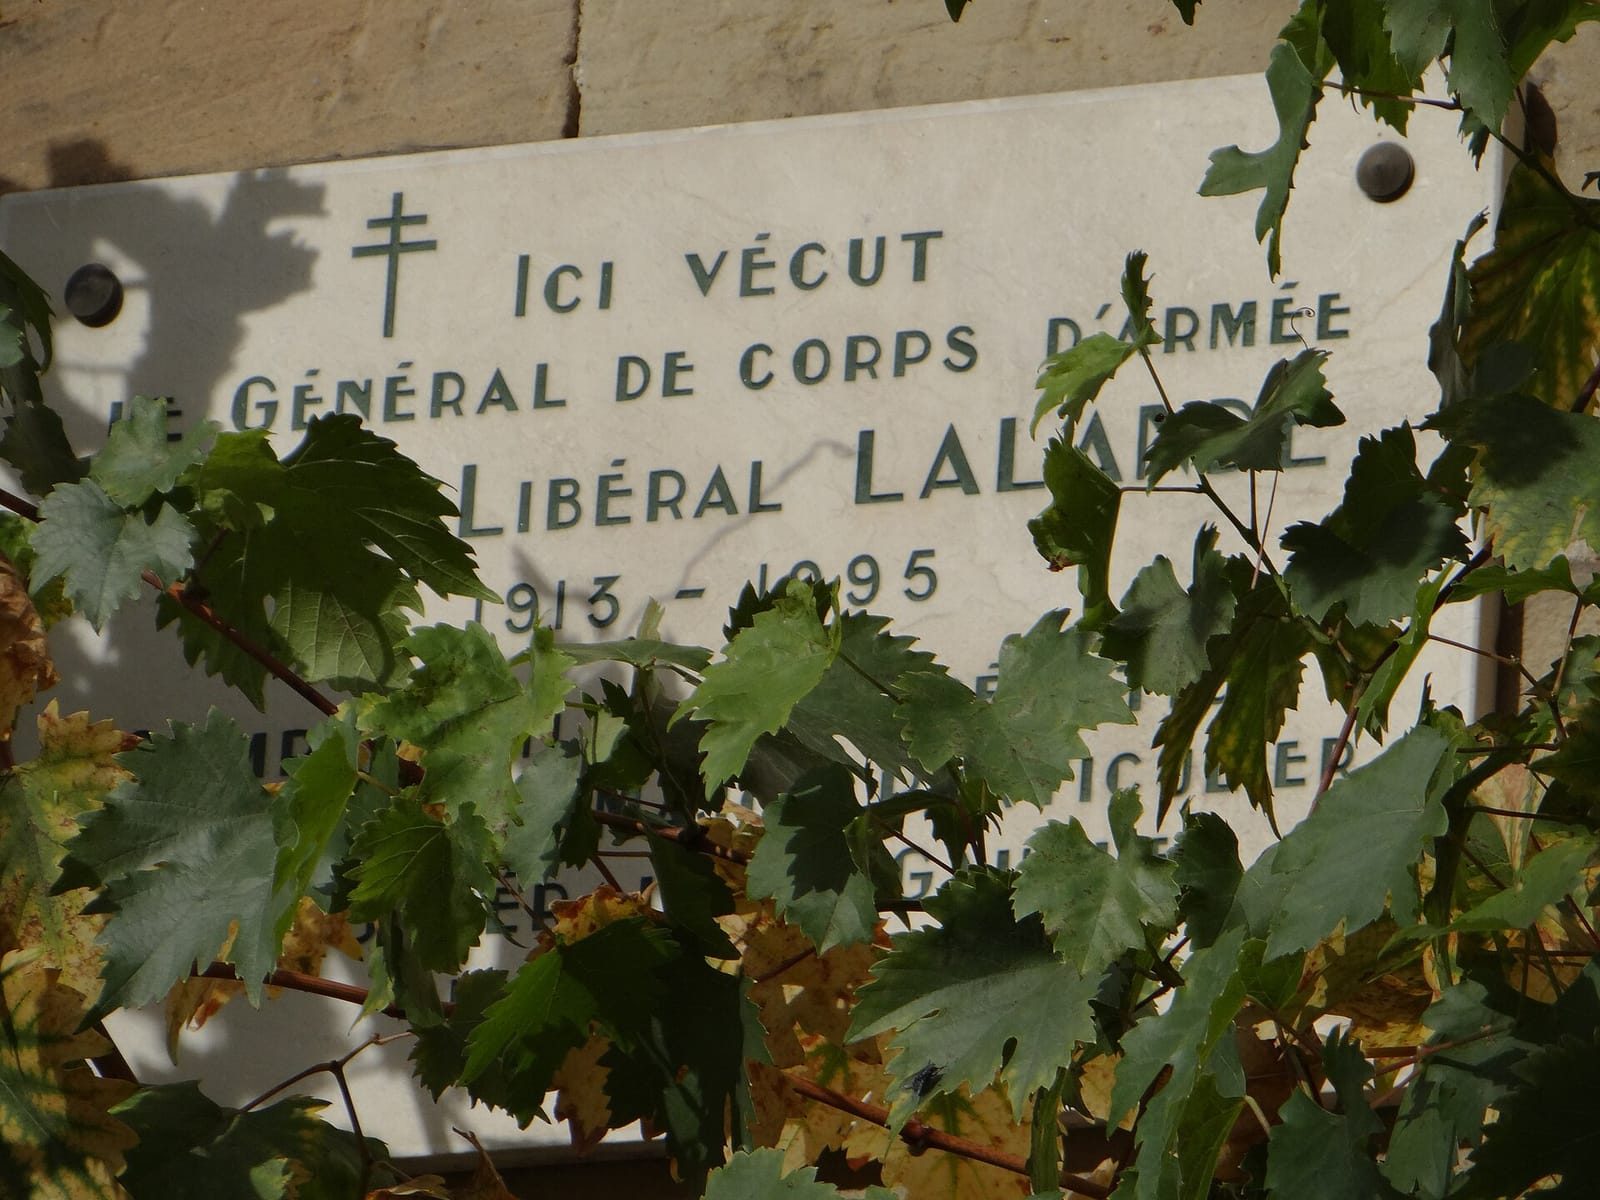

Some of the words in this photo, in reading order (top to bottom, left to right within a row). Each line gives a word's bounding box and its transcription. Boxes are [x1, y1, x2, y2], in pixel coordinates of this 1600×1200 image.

[514, 254, 614, 318] ICI
[686, 232, 943, 297] VÉCUT
[231, 362, 566, 432] GÉNÉRAL
[615, 351, 694, 402] DE
[740, 326, 979, 390] CORPS
[458, 459, 783, 537] LIBÉRAL
